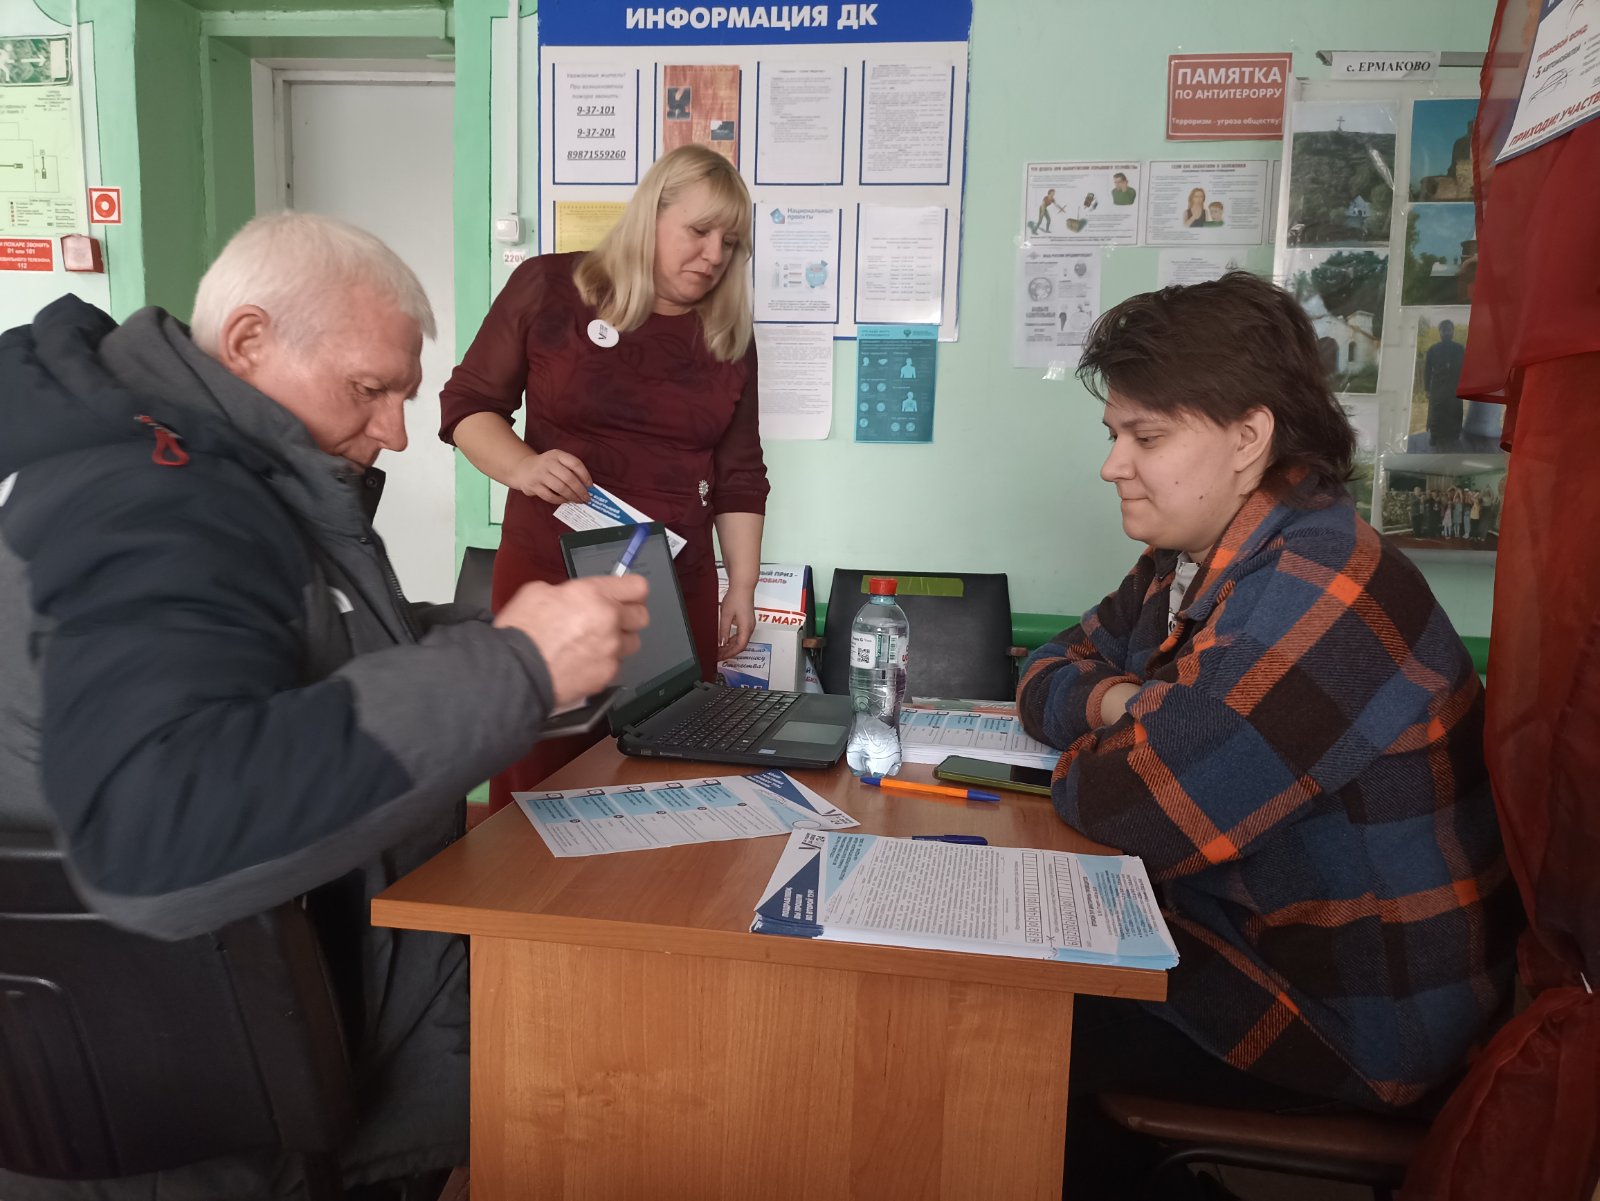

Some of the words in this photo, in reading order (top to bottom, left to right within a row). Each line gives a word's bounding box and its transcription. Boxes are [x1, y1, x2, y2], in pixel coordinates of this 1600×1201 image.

[626, 6, 828, 31] ИНФОРМАЦИЯ
[837, 4, 878, 30] ДК
[1346, 64, 1355, 72] с.
[1359, 61, 1431, 72] ЕРМАКОВО
[1177, 66, 1282, 85] ПАМЯТКА
[1175, 89, 1193, 99] ПО
[1195, 88, 1282, 99] АНТИТЕРОРРУ
[577, 105, 615, 116] 9-37-101
[1172, 118, 1212, 126] Терроризм
[1217, 118, 1242, 126] угроза
[577, 128, 615, 138] 9-37-201
[567, 150, 626, 160] 89871559260
[758, 614, 769, 622] 17
